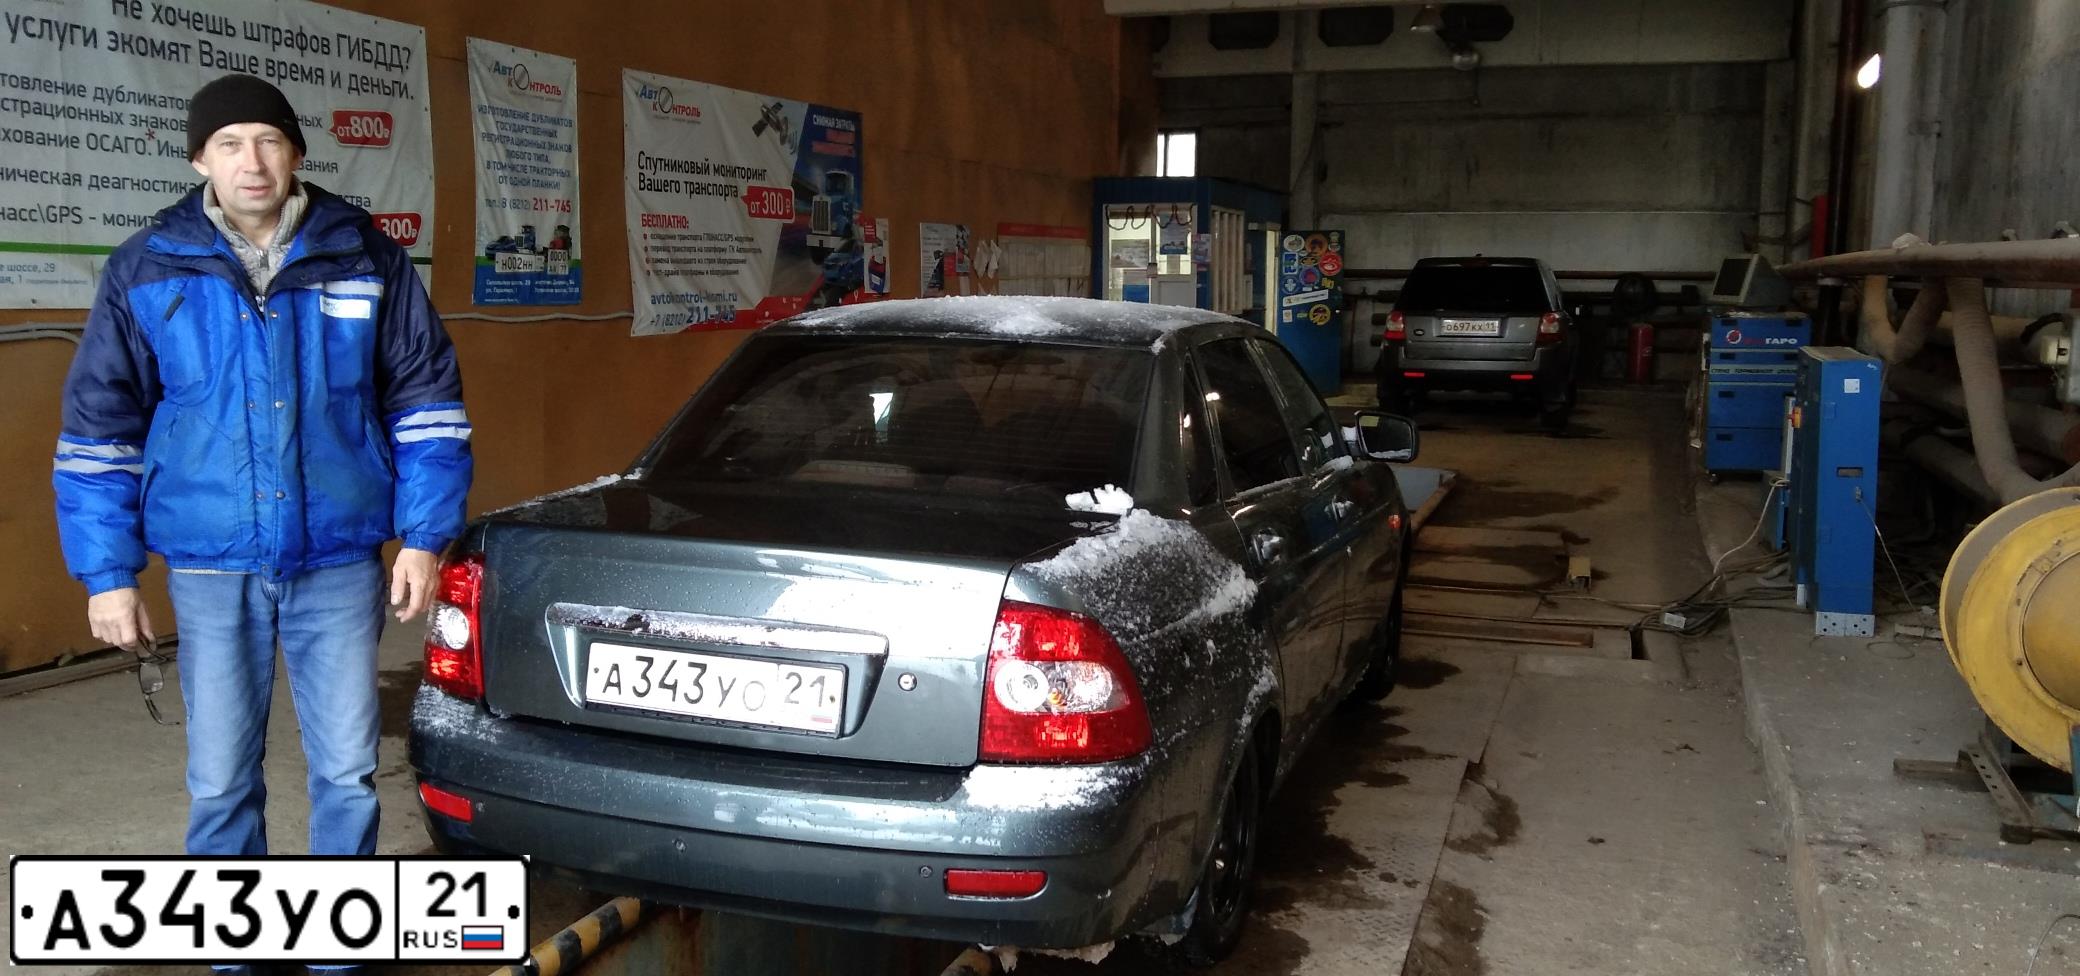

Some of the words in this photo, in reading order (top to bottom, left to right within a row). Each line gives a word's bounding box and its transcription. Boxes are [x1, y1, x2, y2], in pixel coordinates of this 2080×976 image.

[113, 0, 143, 20] Не
[150, 2, 237, 37] хочешь
[243, 21, 331, 58] штрафов
[336, 33, 412, 72] ГИБДД?
[5, 11, 98, 51] услуги
[107, 30, 192, 63] экомят
[199, 38, 259, 74] Ваше
[266, 58, 325, 86] время
[331, 70, 342, 90] и
[349, 72, 414, 100] деньги.
[0, 72, 87, 98] товление
[1, 97, 124, 126] страционных
[129, 114, 188, 133] знаков
[0, 127, 80, 149] хование
[638, 150, 710, 177] Спутниковый
[713, 162, 767, 183] мониторинг
[639, 172, 681, 194] Вашего
[684, 180, 739, 201] транспорта
[338, 195, 372, 208] ства
[762, 191, 782, 216] 300
[641, 213, 689, 229] БЕСПЛАТНО:
[602, 655, 766, 712] А343УО
[784, 671, 828, 708] 21
